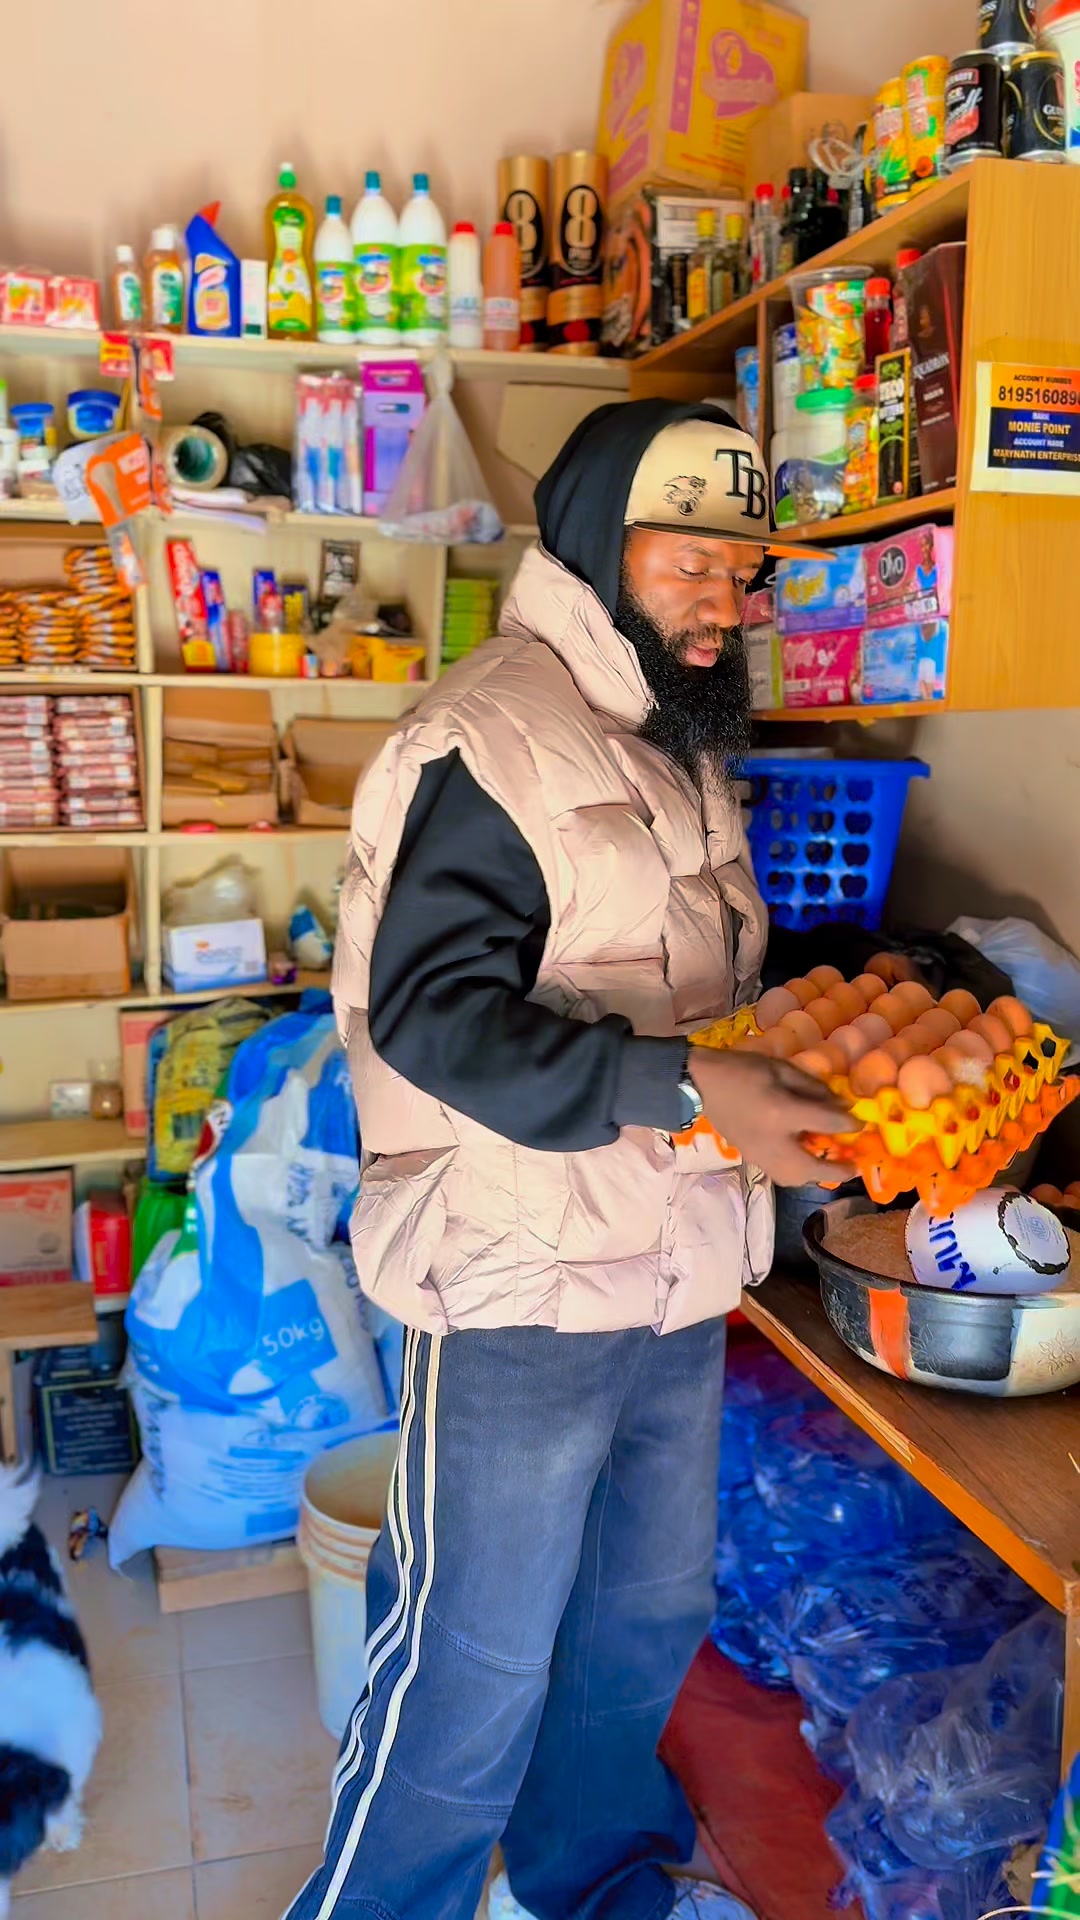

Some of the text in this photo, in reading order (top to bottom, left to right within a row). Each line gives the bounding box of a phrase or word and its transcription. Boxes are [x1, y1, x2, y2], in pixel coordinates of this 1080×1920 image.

[1014, 375, 1071, 384] ACCOUNT NUMBER
[1008, 421, 1071, 435] MONIE POINT
[1013, 438, 1046, 447] ACCOUNT
[261, 1317, 325, 1357] 50kg
